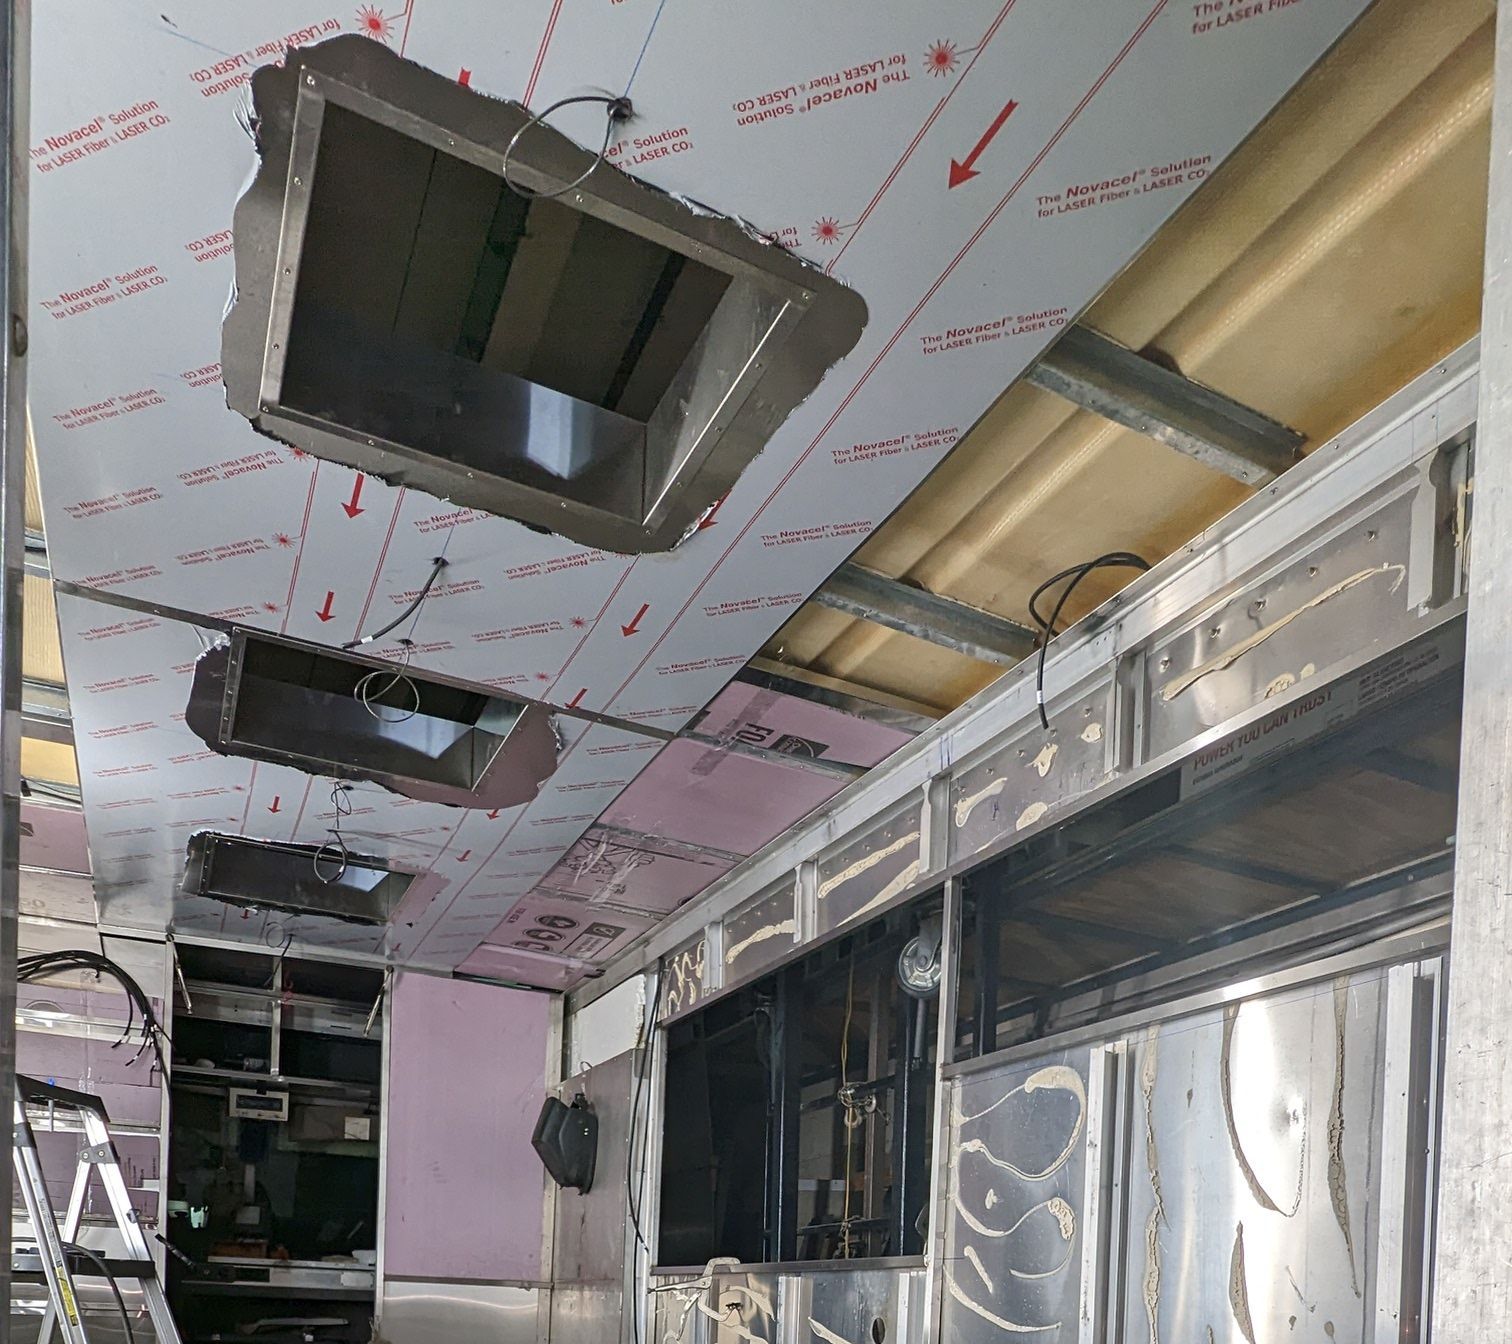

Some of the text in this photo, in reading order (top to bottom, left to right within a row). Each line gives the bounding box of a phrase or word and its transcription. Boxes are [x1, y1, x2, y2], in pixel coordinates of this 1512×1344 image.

[1193, 21, 1212, 34] for
[1217, 3, 1263, 27] LASER
[1194, 2, 1222, 16] The
[324, 19, 341, 31] for
[211, 54, 248, 75] LASER
[844, 60, 885, 80] LASER
[888, 54, 906, 65] for
[809, 73, 840, 89] Fiber
[882, 70, 910, 83] The
[759, 87, 797, 106] LASER
[108, 100, 158, 124] Solution
[738, 103, 794, 126] Solution
[37, 159, 54, 172] for
[51, 148, 86, 167] LASER
[84, 138, 110, 154] Fiber
[115, 121, 149, 141] LASER
[634, 127, 688, 149] Solution
[633, 146, 670, 164] LASER
[1037, 194, 1061, 205] The
[1151, 155, 1211, 177] Solution
[1038, 208, 1054, 218] for
[1057, 197, 1096, 213] LASER
[1100, 190, 1129, 203] Fiber
[1143, 174, 1183, 192] LASER
[40, 300, 62, 309] The
[115, 265, 158, 284] Solution
[66, 301, 95, 316] LASER
[92, 294, 115, 306] Fiber
[120, 281, 151, 296] LASER
[920, 336, 942, 345] The
[1017, 307, 1068, 323] Solution
[923, 347, 937, 355] for
[940, 338, 972, 351] LASER
[976, 332, 1001, 343] Fiber
[1012, 322, 1046, 335] LASER
[831, 449, 850, 457] The
[914, 427, 958, 441] Solution
[849, 451, 877, 462] LASER
[880, 447, 902, 457] Fiber
[911, 439, 940, 450] LASER
[833, 520, 871, 531] Solution
